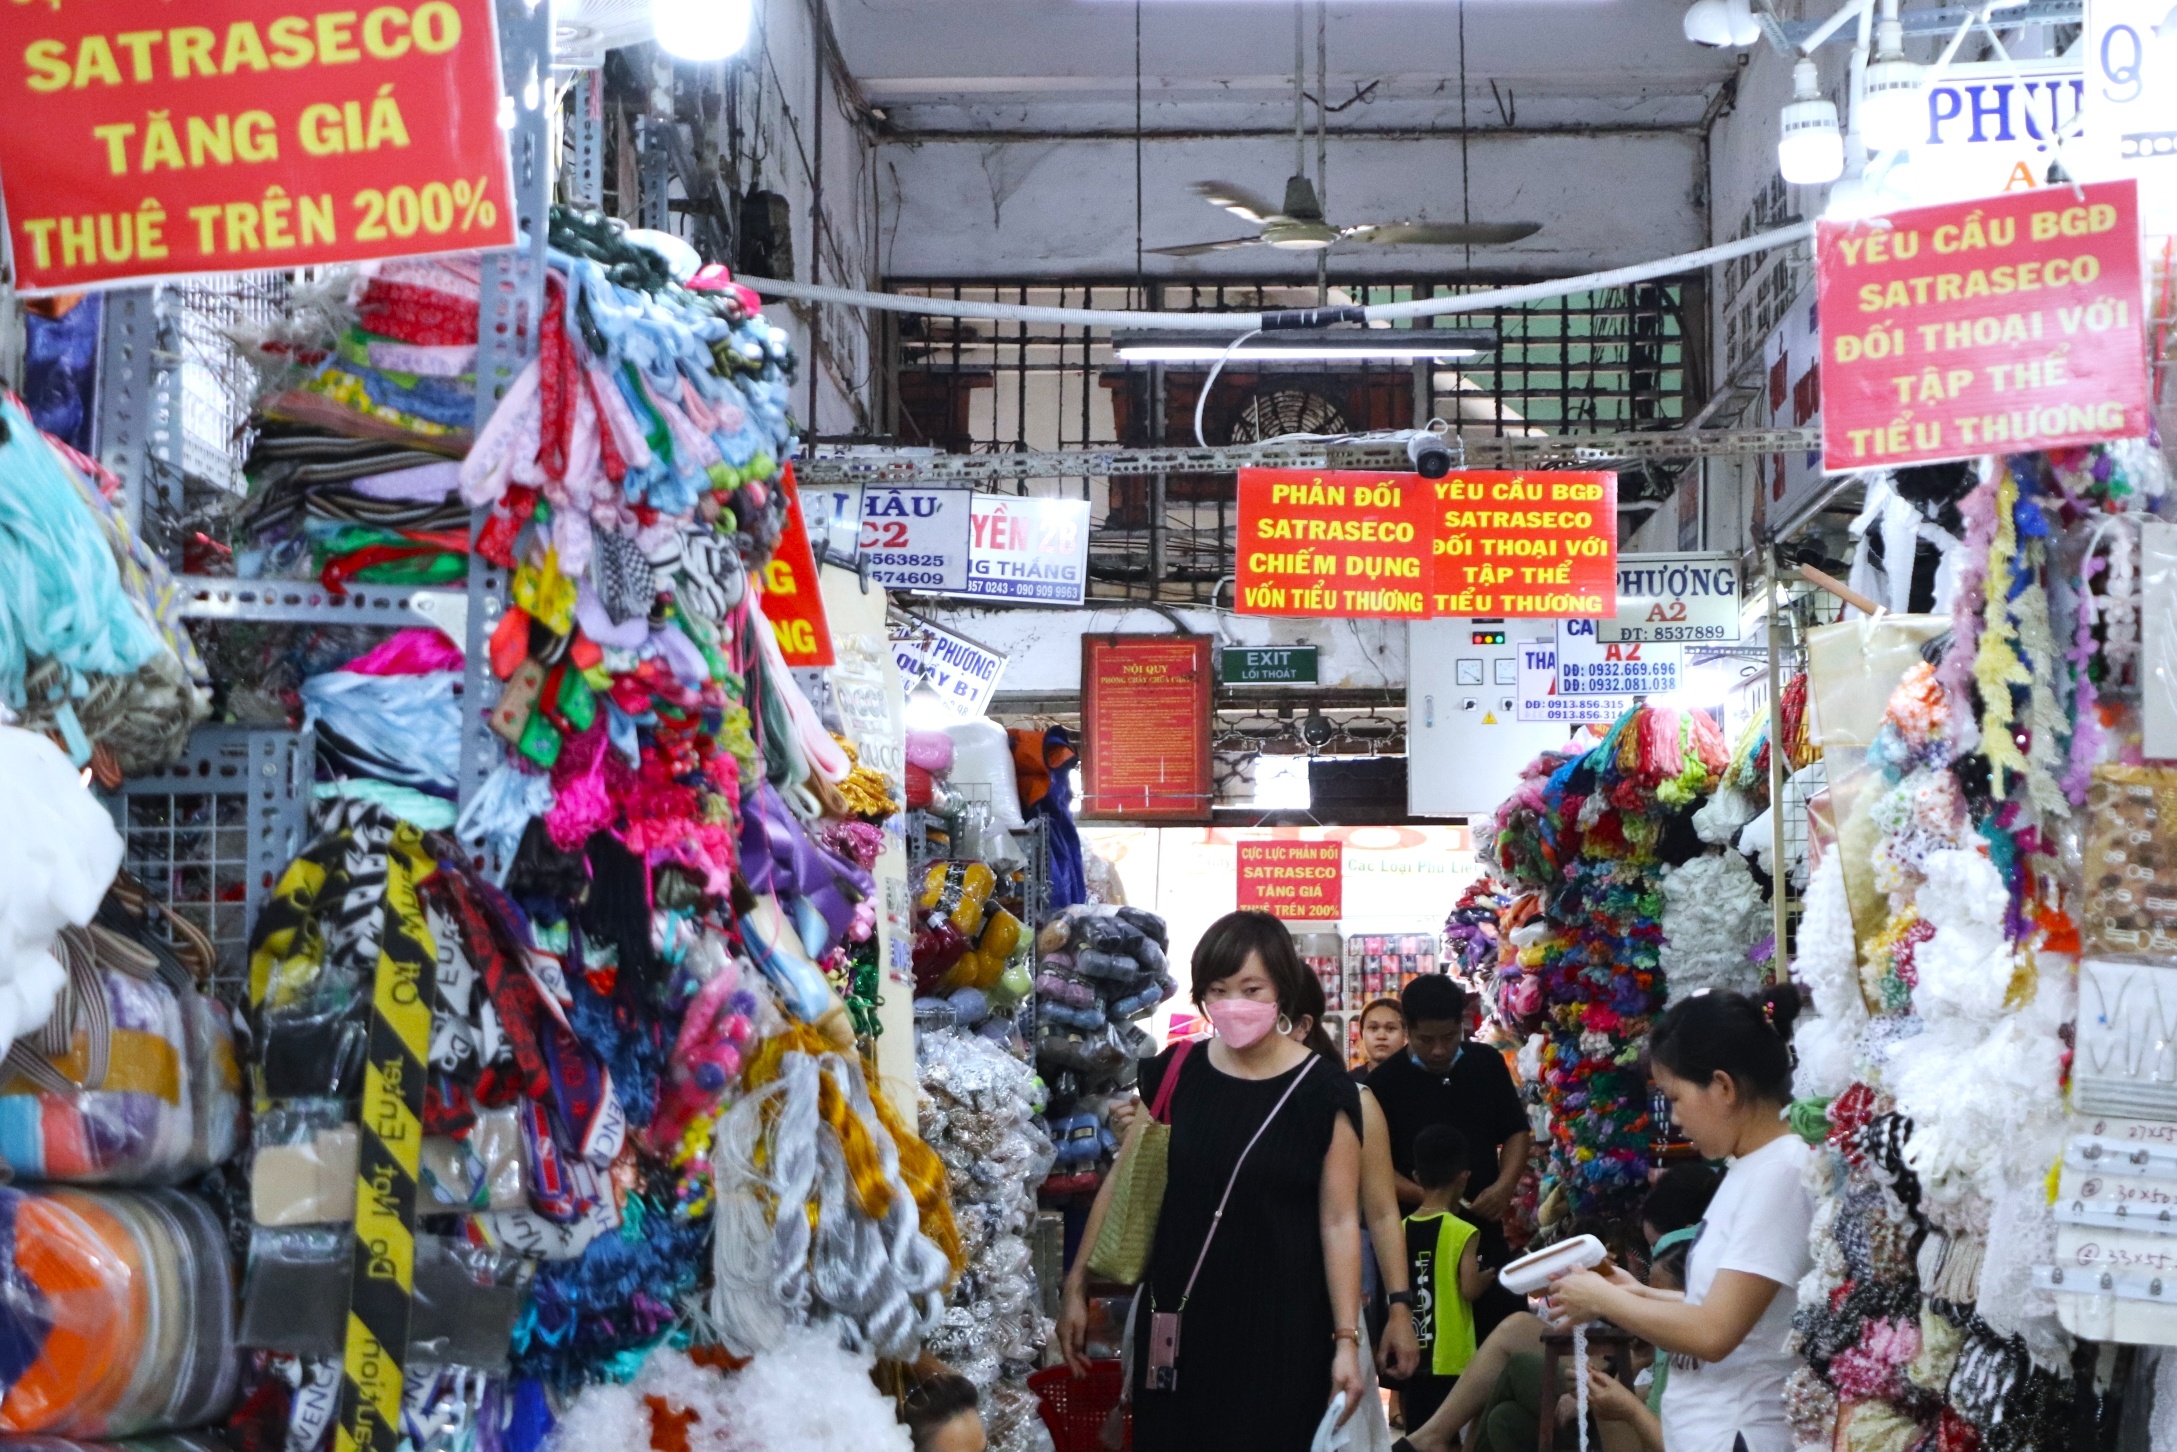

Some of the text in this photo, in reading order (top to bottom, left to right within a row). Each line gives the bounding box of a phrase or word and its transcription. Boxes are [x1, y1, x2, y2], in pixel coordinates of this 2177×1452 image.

[24, 1, 462, 92] SATRASECO
[94, 84, 410, 176] TĂNG GIÁ
[23, 177, 497, 270] THUÊ TRÊN 200%
[1839, 203, 2117, 267] YÊU CẦU BGĐ
[1858, 255, 2100, 313] SATRASECO
[1834, 296, 2129, 364] ĐỐI THOẠI VỚI
[1892, 342, 2071, 406] TẬP THỂ
[1847, 401, 2125, 457] TIỂU THƯƠNG
[1272, 478, 1401, 508] PHẢN ĐỐI
[1433, 476, 1604, 502] YÊU CẦU BGĐ
[1257, 518, 1415, 544] SATRASECO
[1444, 510, 1593, 530] SATRASECO
[860, 521, 910, 549] C2
[1480, 537, 1558, 560] THOẠI
[1565, 535, 1609, 558] VỚI
[869, 553, 945, 567] 563825
[969, 559, 990, 575] G
[1248, 548, 1421, 581] CHIẾM DỤNG
[751, 559, 797, 595] G
[868, 571, 944, 585] 574609
[1463, 559, 1573, 588] TẬP THỂ
[986, 581, 1008, 595] 0243
[1016, 583, 1034, 596] 090
[1037, 584, 1053, 598] 909
[1056, 586, 1078, 599] 9963
[1244, 582, 1424, 614] VỐN TIỂU THƯƠNG
[1432, 585, 1603, 613] TIỂU THƯƠNG
[1645, 601, 1687, 623] A2
[1620, 625, 1725, 641] ĐT: 8537889
[1246, 651, 1292, 667] EXIT
[1605, 643, 1641, 662] A2
[1122, 663, 1168, 675] NỘI QUY
[1242, 667, 1297, 680] LỐI THOÁT
[1563, 662, 1676, 678] DĐ: 0932.669.696
[953, 680, 979, 701] B1
[1563, 678, 1586, 692] DĐ:
[1588, 677, 1676, 692] 0932.081.038
[1525, 699, 1624, 710] DĐ: 0913.856.315
[1241, 844, 1339, 861] CỰC LỰC PHẢN ĐỐI
[1243, 866, 1337, 879] SATRASECO
[1256, 883, 1323, 898] TĂNG GIÁ
[1274, 902, 1306, 916] TRÊN
[1308, 904, 1340, 916] 200%
